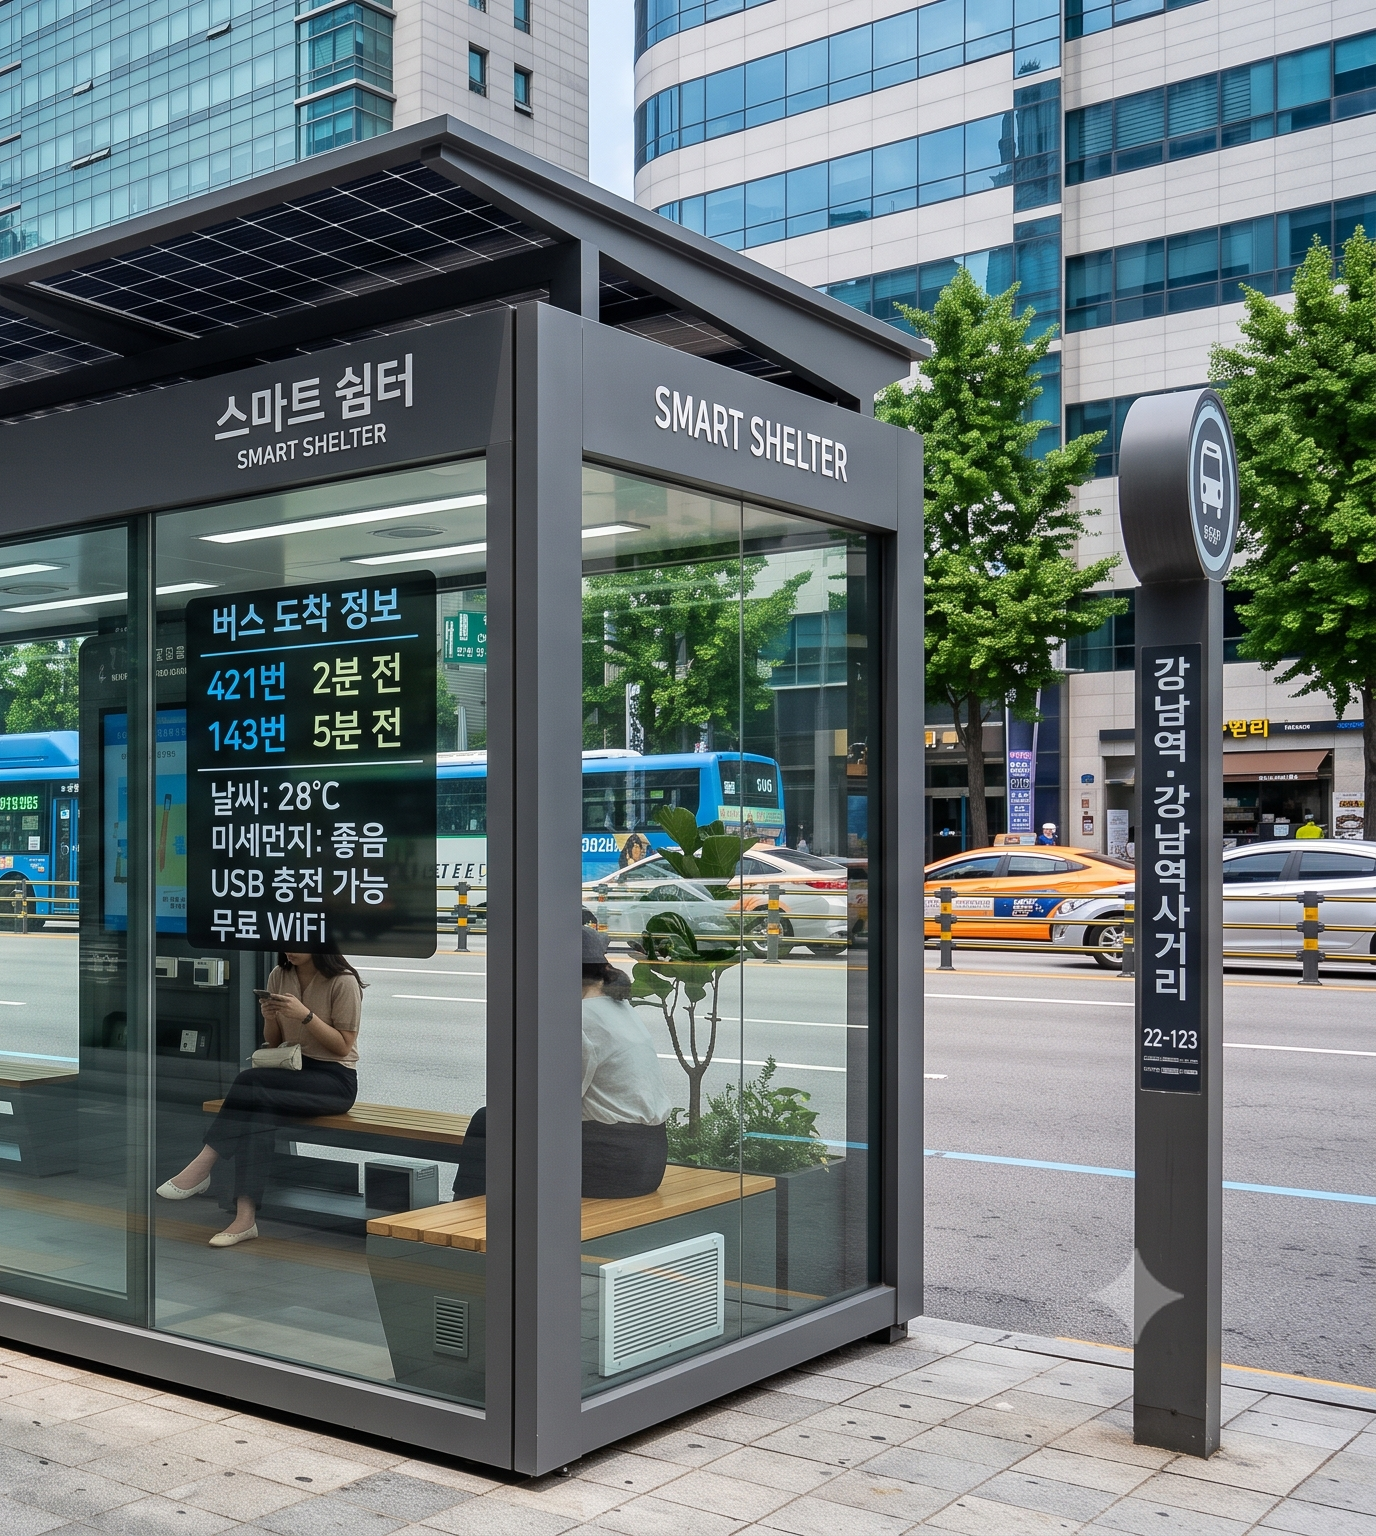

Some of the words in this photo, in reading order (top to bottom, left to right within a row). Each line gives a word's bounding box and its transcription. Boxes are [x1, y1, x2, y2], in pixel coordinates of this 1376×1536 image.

[215, 377, 325, 440] 스마트
[335, 353, 413, 420] 쉼터
[237, 439, 299, 470] SMART
[302, 423, 386, 457] SHELTER
[655, 385, 743, 451] SMART
[750, 415, 848, 483] SHELTER
[213, 603, 266, 642] 버스
[273, 593, 331, 633] 도착
[340, 588, 402, 630] 정보
[207, 661, 286, 701] 421번
[313, 656, 362, 697] 2분
[371, 652, 401, 694] 전
[208, 714, 286, 753] 143번
[313, 710, 362, 751] 5분
[371, 707, 401, 748] 전
[211, 779, 269, 816] 날씨:
[278, 780, 341, 811] 28°C
[212, 822, 322, 858] 미세먼지:
[330, 822, 388, 859] 좋음
[211, 868, 265, 898] USB
[271, 866, 324, 903] 충전
[332, 867, 389, 905] 가능
[210, 909, 261, 942] 무료
[267, 911, 326, 943] WiFi
[1143, 1028, 1198, 1050] 22-123
